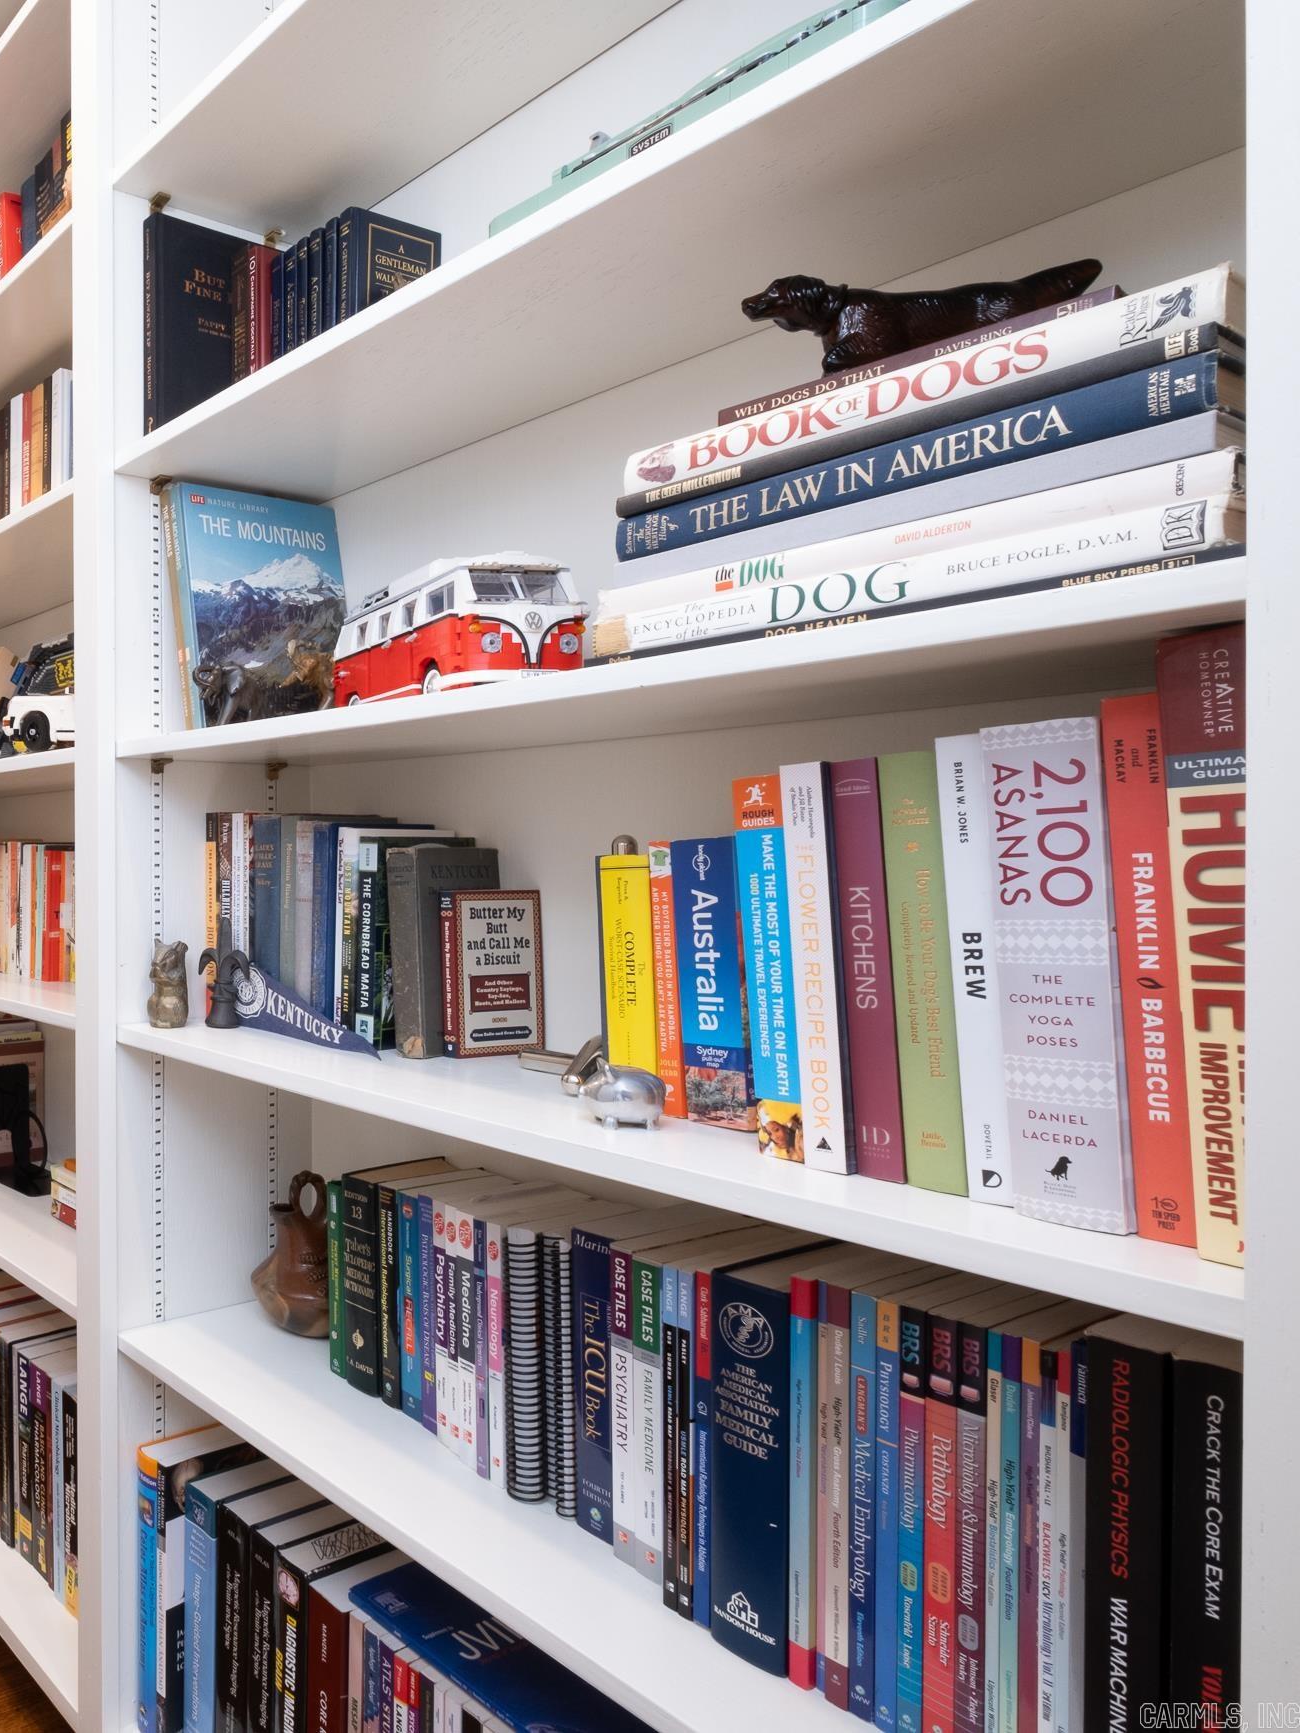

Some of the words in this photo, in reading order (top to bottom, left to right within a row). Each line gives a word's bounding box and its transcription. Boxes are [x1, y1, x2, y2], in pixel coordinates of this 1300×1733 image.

[632, 124, 670, 156] SYSTEM
[193, 268, 226, 289] BUT
[375, 254, 427, 275] GENTLEMAN
[183, 280, 222, 301] FINE
[687, 394, 842, 472] BOOK
[835, 395, 864, 415] OF
[864, 330, 1049, 421] DOGS
[735, 401, 767, 419] WHY
[771, 388, 810, 409] DOGS
[815, 380, 837, 395] DO
[843, 365, 886, 386] THAT
[645, 489, 661, 503] THE
[682, 466, 742, 494] MILLENNIUM
[689, 494, 749, 534] THE
[758, 470, 828, 517] LAW
[835, 457, 875, 496] IN
[884, 405, 1073, 482] AMERICA
[1176, 463, 1186, 497] CRESCENT
[191, 495, 205, 504] LIFE
[199, 514, 232, 538] THE
[237, 520, 327, 552] MOUNTAINS
[895, 529, 921, 545] DAVID
[923, 520, 972, 540] ALDERTON
[1166, 503, 1197, 545] DK
[715, 566, 734, 582] the
[739, 553, 784, 587] DOG
[947, 557, 1001, 576] BRUCE
[1006, 543, 1071, 566] FOGLE,
[1078, 529, 1138, 551] D.V.M.
[767, 562, 910, 624] DOG
[1062, 575, 1091, 587] BLUE
[1094, 570, 1118, 582] SKY
[1120, 563, 1159, 577] PRESS
[633, 603, 756, 635] ENCYCLOPEDIA
[804, 614, 868, 633] HEAVEN
[1213, 649, 1235, 732] CREATIVE
[1115, 740, 1126, 783] MACKAY
[1132, 748, 1142, 767] and
[1147, 729, 1159, 783] FRANKLIN
[954, 762, 964, 792] BRIAN
[742, 809, 774, 819] ROUGH
[957, 796, 966, 810] W.
[742, 818, 775, 828] GUIDES
[958, 811, 968, 844] JONES
[992, 763, 1032, 906] ASANAS
[1030, 758, 1093, 907] 2,100
[761, 834, 775, 870] MAKE
[362, 878, 371, 898] THE
[749, 872, 760, 896] 1000
[765, 873, 776, 898] THE
[915, 869, 931, 898] How
[469, 907, 504, 920] Butter
[507, 906, 525, 921] My
[752, 898, 763, 948] ULTIMATE
[766, 901, 779, 938] MOST
[797, 853, 819, 954] FLOWER
[919, 904, 928, 916] to
[1131, 852, 1161, 970] FRANKLIN
[361, 901, 371, 970] CORNBREAD
[467, 939, 486, 951] and
[489, 938, 510, 949] Call
[513, 938, 530, 949] Me
[486, 922, 508, 935] Butt
[768, 940, 780, 956] OF
[849, 887, 878, 1009] KITCHENS
[476, 957, 481, 966] a
[484, 954, 521, 966] Biscuit
[624, 931, 636, 1006] COMPLETE
[691, 888, 725, 1031] Australia
[754, 949, 765, 986] TRAVEL
[920, 936, 935, 965] Your
[962, 932, 987, 1000] BREW
[360, 973, 370, 1008] MAFIA
[770, 957, 783, 993] YOUR
[1032, 974, 1063, 985] THE
[265, 987, 343, 1044] KENTUCKY
[772, 995, 786, 1029] TIME
[804, 961, 827, 1050] RECIPE
[926, 1007, 940, 1031] Best
[1009, 993, 1096, 1007] COMPLETE
[758, 988, 771, 1058] EXPERIENCES
[775, 1031, 786, 1049] ON
[1028, 1014, 1074, 1027] YOGA
[696, 1046, 729, 1058] Sydney
[928, 1036, 946, 1079] Friend
[1027, 1035, 1078, 1048] POSES
[1141, 998, 1170, 1123] BARBECUE
[776, 1052, 790, 1097] EARTH
[810, 1059, 831, 1130] BOOK
[1029, 1110, 1088, 1126] DANIEL
[1199, 1042, 1238, 1225] IMPROVEMENT
[1022, 1129, 1098, 1148] LACERDA
[351, 1205, 363, 1220] 13
[614, 1257, 626, 1290] CASE
[641, 1269, 652, 1301] CASE
[435, 1254, 445, 1341] Psychiatry
[462, 1269, 471, 1349] Medicine
[615, 1291, 626, 1332] FILES
[490, 1288, 498, 1360] Neurology
[584, 1302, 600, 1334] The
[641, 1303, 653, 1343] FILES
[902, 1320, 920, 1366] BRS
[933, 1327, 952, 1374] BRS
[963, 1337, 980, 1378] BRS
[585, 1338, 606, 1398] ICU
[720, 1368, 773, 1394] AMERICAN
[735, 1363, 757, 1378] THE
[19, 1358, 27, 1420] LANGE
[615, 1353, 628, 1454] PSYCHIATRY
[643, 1369, 653, 1415] FAMILY
[715, 1386, 780, 1417] ASSOCIATION
[723, 1378, 769, 1403] MEDICAL
[879, 1361, 893, 1433] PHYSIOLOGY
[585, 1398, 602, 1441] Book
[715, 1411, 779, 1448] MEDICAL
[719, 1399, 773, 1430] FAMILY
[1111, 1359, 1130, 1488] RADIOLOGIC
[1206, 1393, 1225, 1463] CRACK
[644, 1416, 654, 1476] MEDICINE
[723, 1432, 768, 1460] GUIDE
[958, 1422, 980, 1509] Microbiology
[855, 1437, 871, 1502] Medical
[899, 1426, 919, 1535] Pharmacology
[927, 1433, 953, 1529] Pathology
[1206, 1466, 1222, 1503] THE
[850, 1504, 871, 1603] Embryology
[1111, 1491, 1130, 1580] PHYSICS
[1205, 1506, 1224, 1562] CORE
[958, 1524, 979, 1611] Immunology
[1205, 1563, 1224, 1621] EXAM
[714, 1605, 745, 1631] RANDOM
[746, 1626, 776, 1646] HOUSE
[1110, 1596, 1128, 1645] WAR
[284, 1614, 297, 1691] DIAGNOSTIC
[939, 1618, 950, 1668] Schneider
[191, 1647, 201, 1722] Interventions
[319, 1690, 328, 1720] CORE
